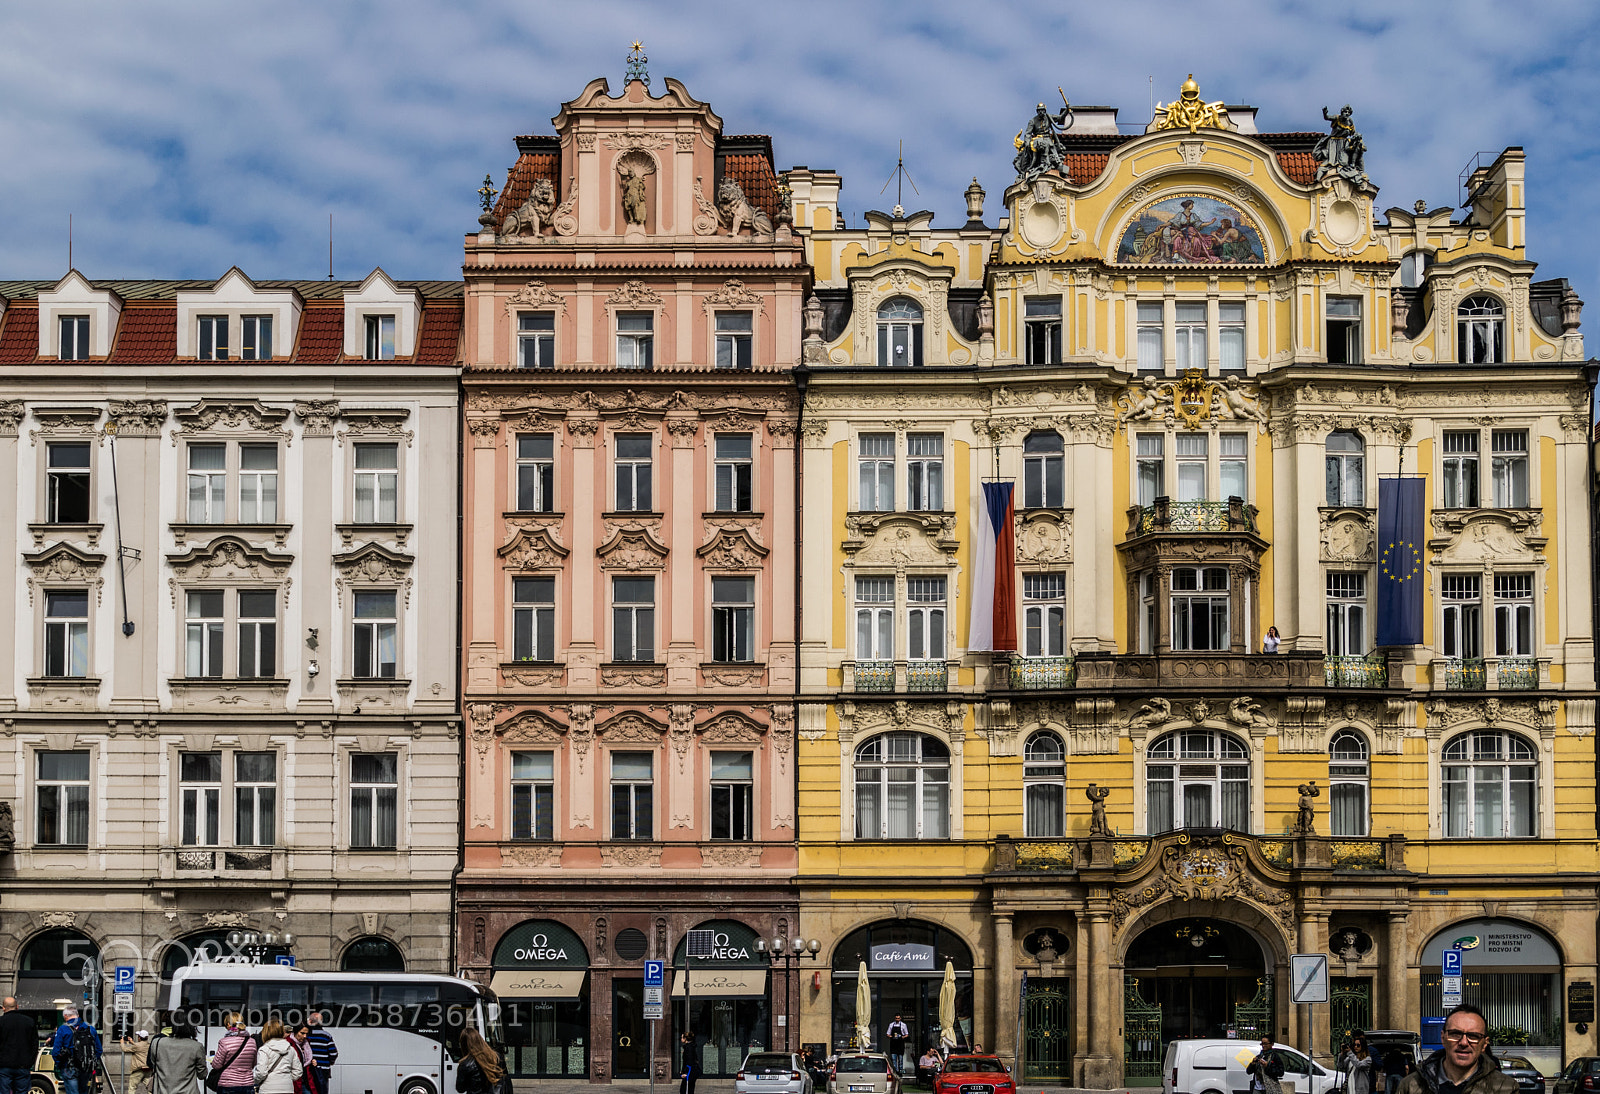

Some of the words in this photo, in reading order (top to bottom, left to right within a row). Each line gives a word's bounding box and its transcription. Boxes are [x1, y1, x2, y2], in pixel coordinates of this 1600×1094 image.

[514, 948, 568, 960] OMEGA
[697, 947, 750, 960] MEGA
[875, 951, 903, 963] Café
[903, 952, 930, 961] Ami
[1446, 953, 1458, 968] P
[119, 969, 131, 985] P
[648, 963, 660, 979] P
